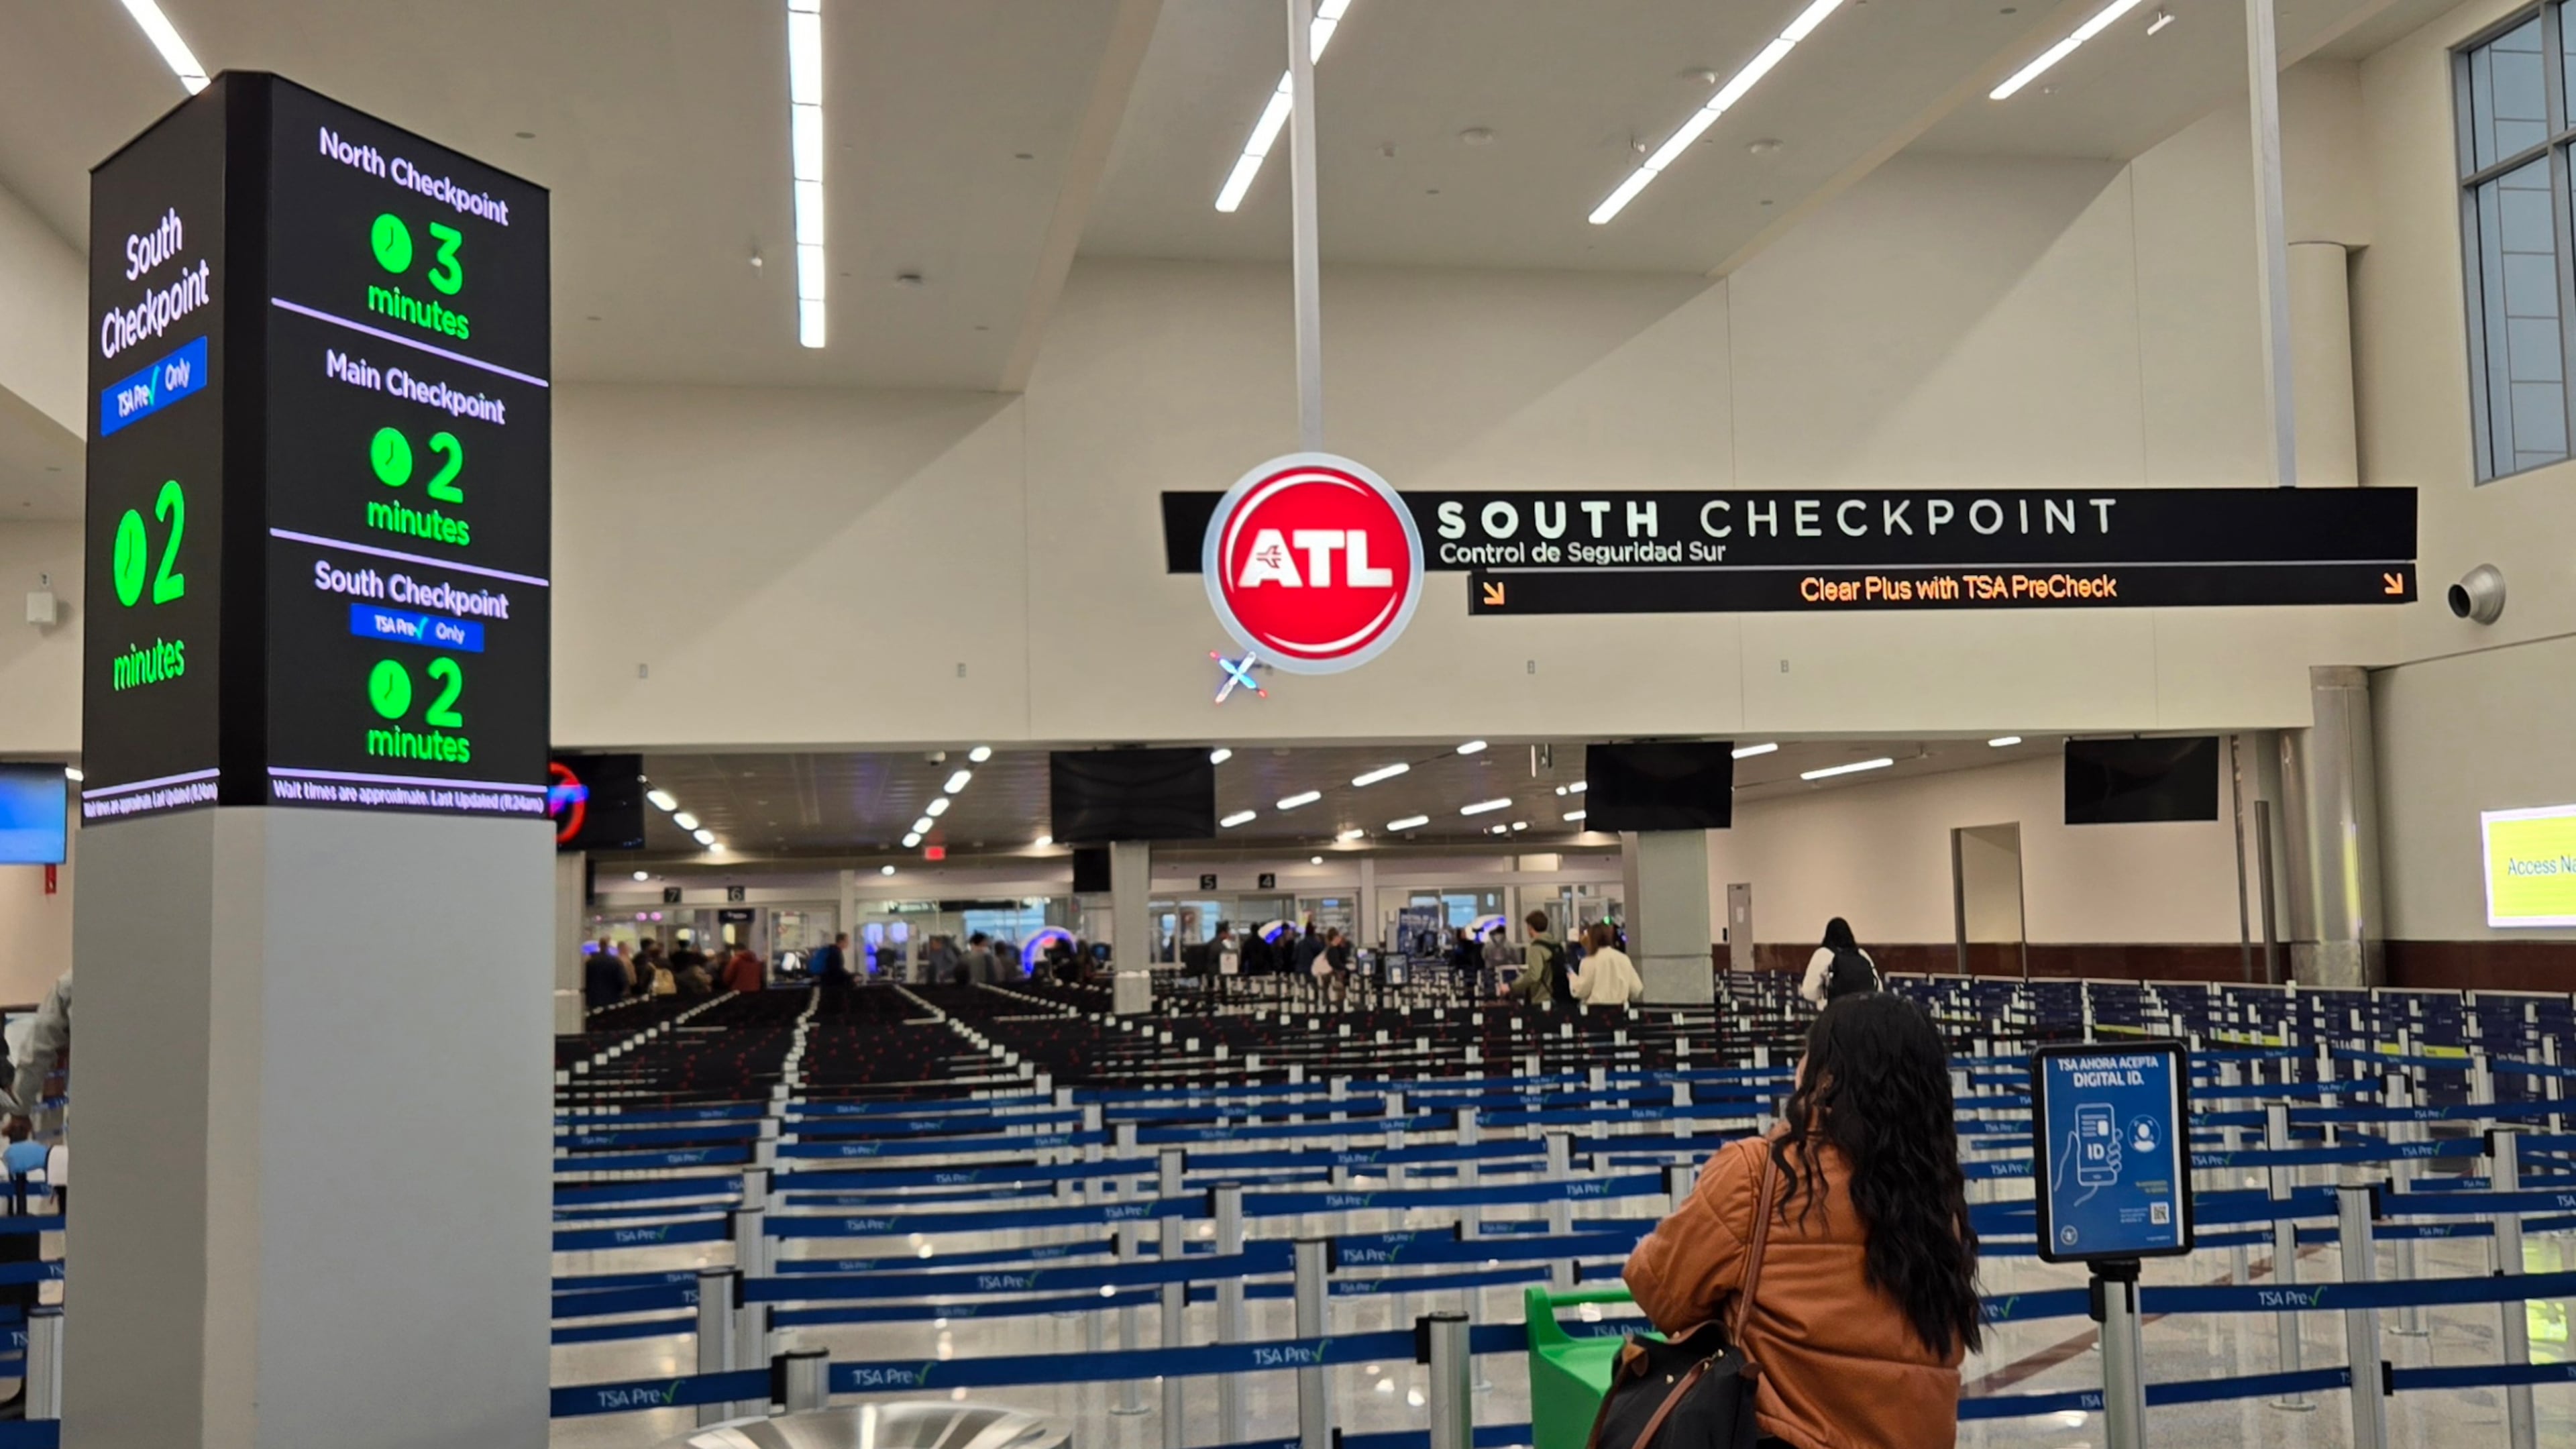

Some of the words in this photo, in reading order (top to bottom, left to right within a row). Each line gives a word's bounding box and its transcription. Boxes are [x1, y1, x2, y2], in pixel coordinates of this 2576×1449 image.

[319, 127, 386, 177] North
[391, 159, 509, 227] Checkpoint
[126, 208, 182, 282] South
[427, 221, 464, 295] 3
[101, 260, 210, 360] Checkpoint
[368, 286, 470, 341] minutes
[165, 360, 190, 392] Only
[326, 350, 380, 390] Main
[386, 368, 506, 425] Checkpoint
[427, 432, 464, 504] 2
[367, 500, 470, 546] minutes
[1438, 500, 1659, 539] SOUTH
[1700, 499, 2118, 537] CHECKPOINT
[153, 480, 185, 604] 2
[1238, 529, 1393, 588] ATL
[1440, 542, 1525, 564] Control
[1532, 542, 1561, 563] de
[1568, 539, 1681, 565] Seguridad
[1688, 541, 1725, 562] Sur
[315, 561, 384, 600] South
[390, 575, 510, 620] Checkpoint
[1801, 576, 1859, 602] Clear
[1865, 575, 1911, 600] Plus
[1917, 576, 1958, 599] with
[1963, 575, 2008, 599] TSA
[2012, 573, 2117, 598] PreCheck
[374, 616, 397, 634] TSA
[435, 624, 465, 644] Only
[113, 638, 185, 690] minutes
[425, 657, 464, 727] 2
[367, 728, 470, 763] minutes
[273, 780, 302, 799] Wait
[304, 782, 337, 801] times
[338, 786, 358, 802] are
[431, 790, 453, 806] Last
[455, 792, 498, 809] Updated
[2508, 857, 2557, 875] Access
[2057, 1059, 2078, 1070] TSA
[2079, 1057, 2117, 1069] AHORA
[2120, 1056, 2158, 1069] ACEPTA
[2074, 1072, 2125, 1087] DIGITAL
[667, 1155, 682, 1163] TSA
[843, 1146, 857, 1155] TSA
[1338, 1155, 1352, 1163] TSA
[1354, 1154, 1367, 1162] Pre
[2088, 1144, 2104, 1161] ID
[2402, 1146, 2417, 1156] TSA
[2419, 1146, 2432, 1155] Pre
[1991, 1164, 2006, 1174] TSA
[2008, 1163, 2023, 1173] Pre
[2192, 1155, 2208, 1165] TSA
[2209, 1155, 2223, 1164] Pre
[729, 1181, 744, 1189] TSA
[935, 1174, 951, 1183] TSA
[953, 1174, 969, 1182] Pre
[1566, 1185, 1583, 1194] TSA
[1586, 1185, 1601, 1193] Pre
[1326, 1196, 1344, 1205] TSA
[1346, 1195, 1362, 1204] Pre
[1106, 1208, 1124, 1218] TSA
[1126, 1206, 1142, 1215] Pre
[846, 1220, 866, 1230] TSA
[869, 1219, 885, 1229] Pre
[614, 1232, 635, 1242] TSA
[639, 1230, 655, 1239] Pre
[1344, 1249, 1365, 1261] TSA
[1366, 1248, 1387, 1261] Pre
[50, 1265, 64, 1276] TS
[839, 1261, 853, 1270] TSA
[854, 1260, 868, 1269] Pre
[977, 1276, 1000, 1289] TSA
[1004, 1275, 1024, 1287] Pre
[682, 1289, 698, 1303] TS
[2259, 1291, 2283, 1305] TSA
[2287, 1291, 2307, 1305] Pre
[11, 1332, 28, 1345] TS
[1252, 1348, 1282, 1364] TSA
[1286, 1347, 1310, 1362] Pre
[852, 1370, 882, 1385] TSA
[887, 1368, 913, 1383] Pre
[597, 1390, 627, 1408] TSA
[631, 1388, 660, 1403] Pre
[2081, 1395, 2100, 1407] TSA
